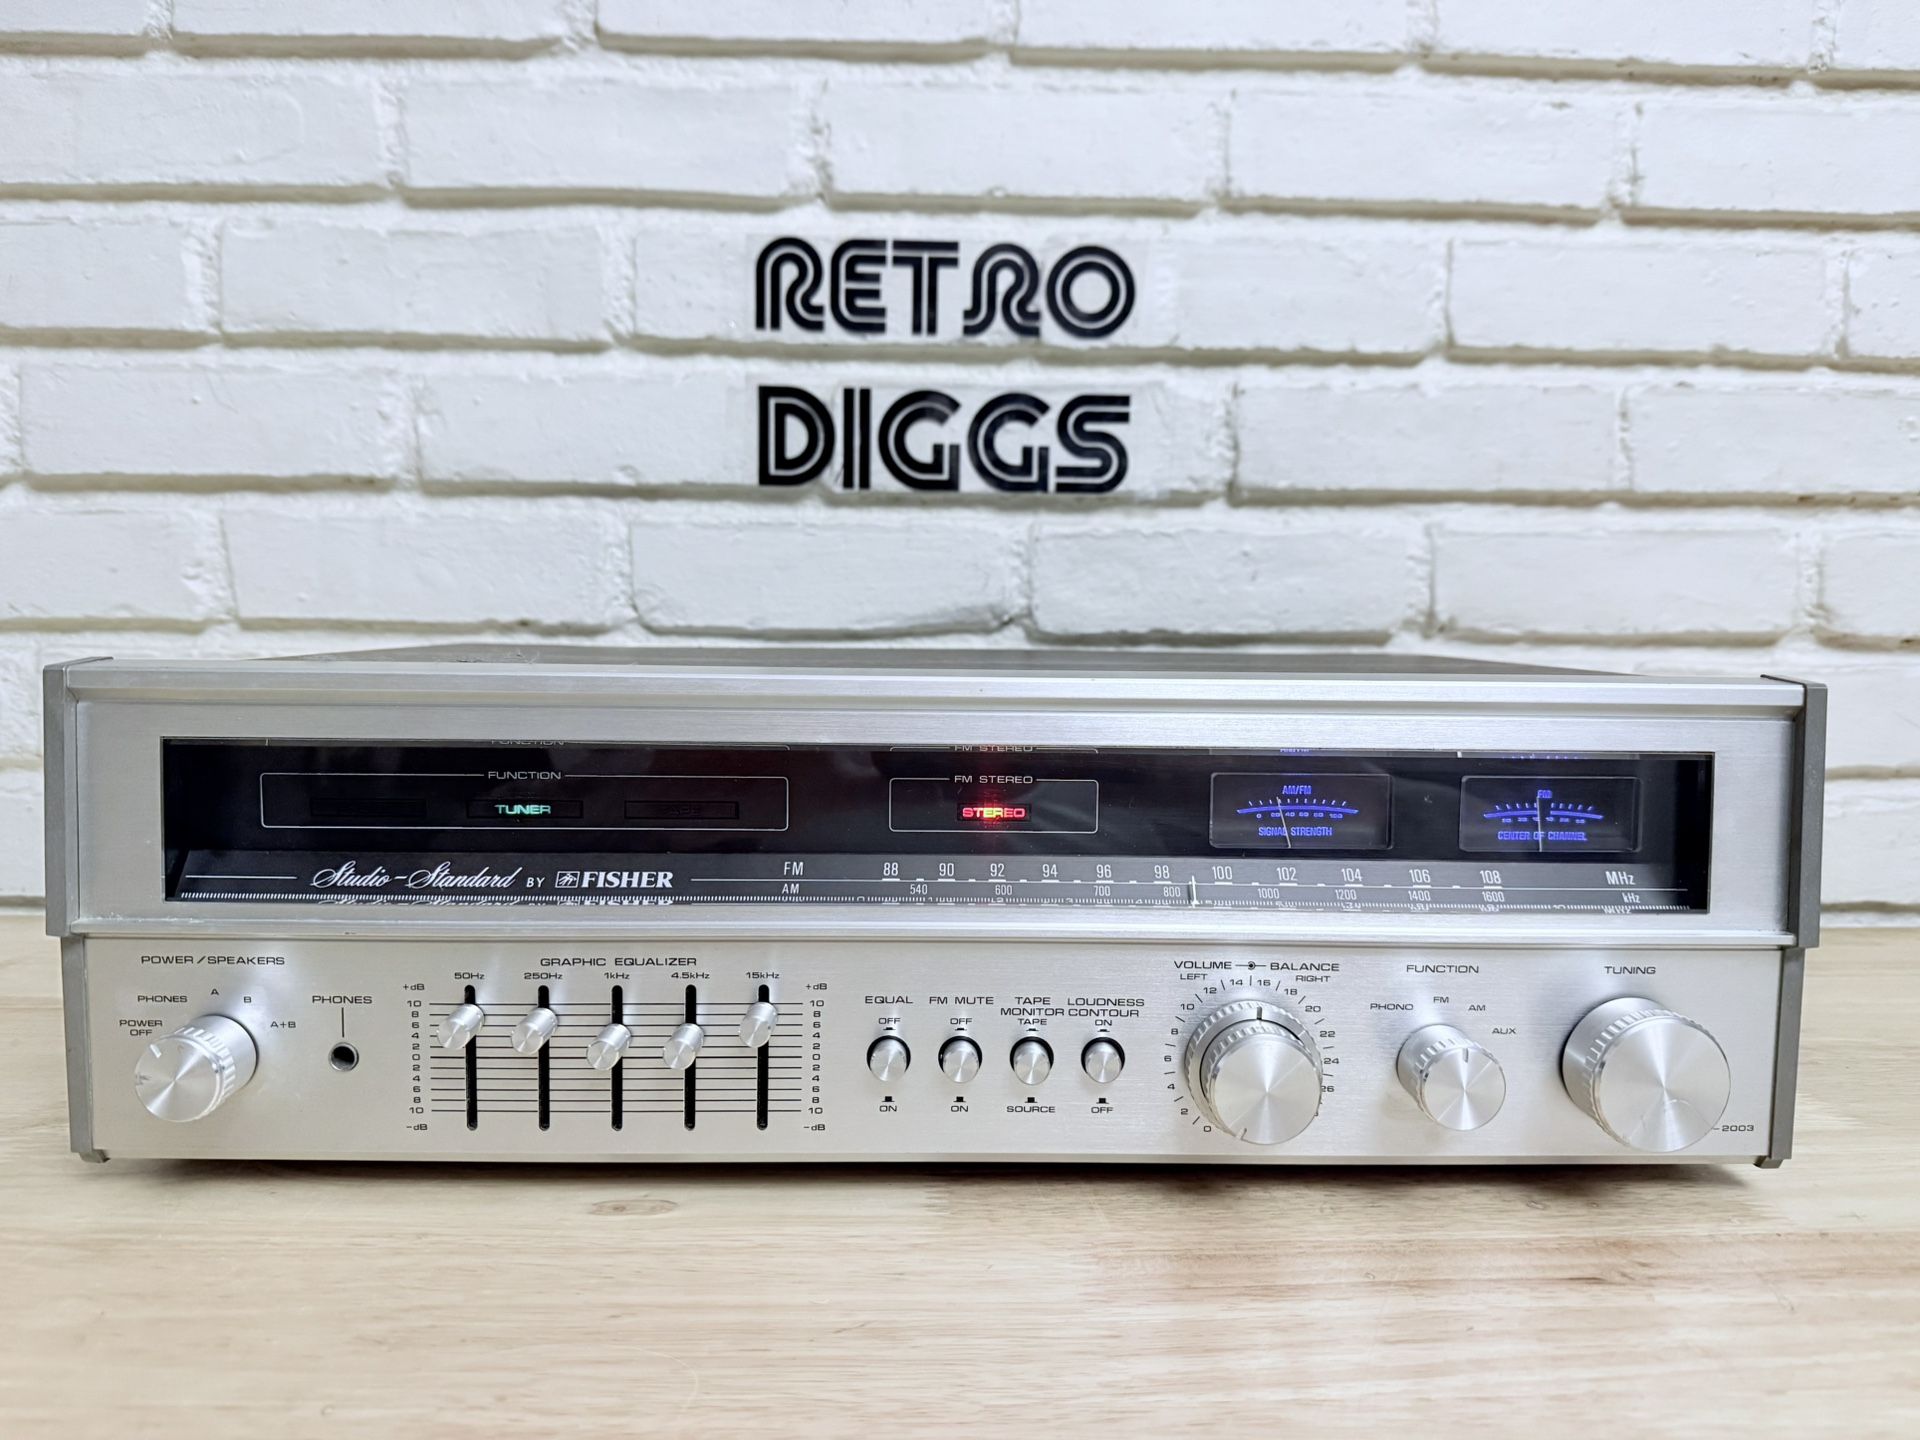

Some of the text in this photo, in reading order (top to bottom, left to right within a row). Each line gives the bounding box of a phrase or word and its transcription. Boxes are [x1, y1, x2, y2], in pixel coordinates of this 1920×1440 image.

[755, 236, 1136, 339] RETRO
[758, 384, 1131, 493] DIGGS
[488, 771, 561, 779] FUNCTION
[1282, 785, 1312, 794] AM/FM
[494, 804, 551, 814] TUNER
[962, 807, 1026, 818] STEREO
[1291, 827, 1332, 836] STRENGTH
[1498, 831, 1530, 840] CENTER
[784, 861, 1635, 885] FM 88 90 92 94 96 98 100 102 104 106 108 MHz
[526, 877, 545, 888] BY
[581, 871, 673, 888] FISHER
[782, 883, 1640, 903] AM 540 600 700 800 1000 1200 1400 1600 kHz
[540, 958, 697, 966] GRAPHIC EQUALIZER
[1174, 961, 1340, 971] VOLUME BALANCE
[1407, 965, 1479, 973] FUNCTION
[1604, 966, 1656, 974] TUNING
[312, 996, 372, 1004] PHONES
[865, 996, 913, 1004] EQUAL
[1067, 998, 1144, 1007] LOUDNESS
[1000, 1008, 1064, 1016] MONITOR
[1068, 1008, 1139, 1017] CONTOUR
[1091, 1106, 1113, 1114] OFF
